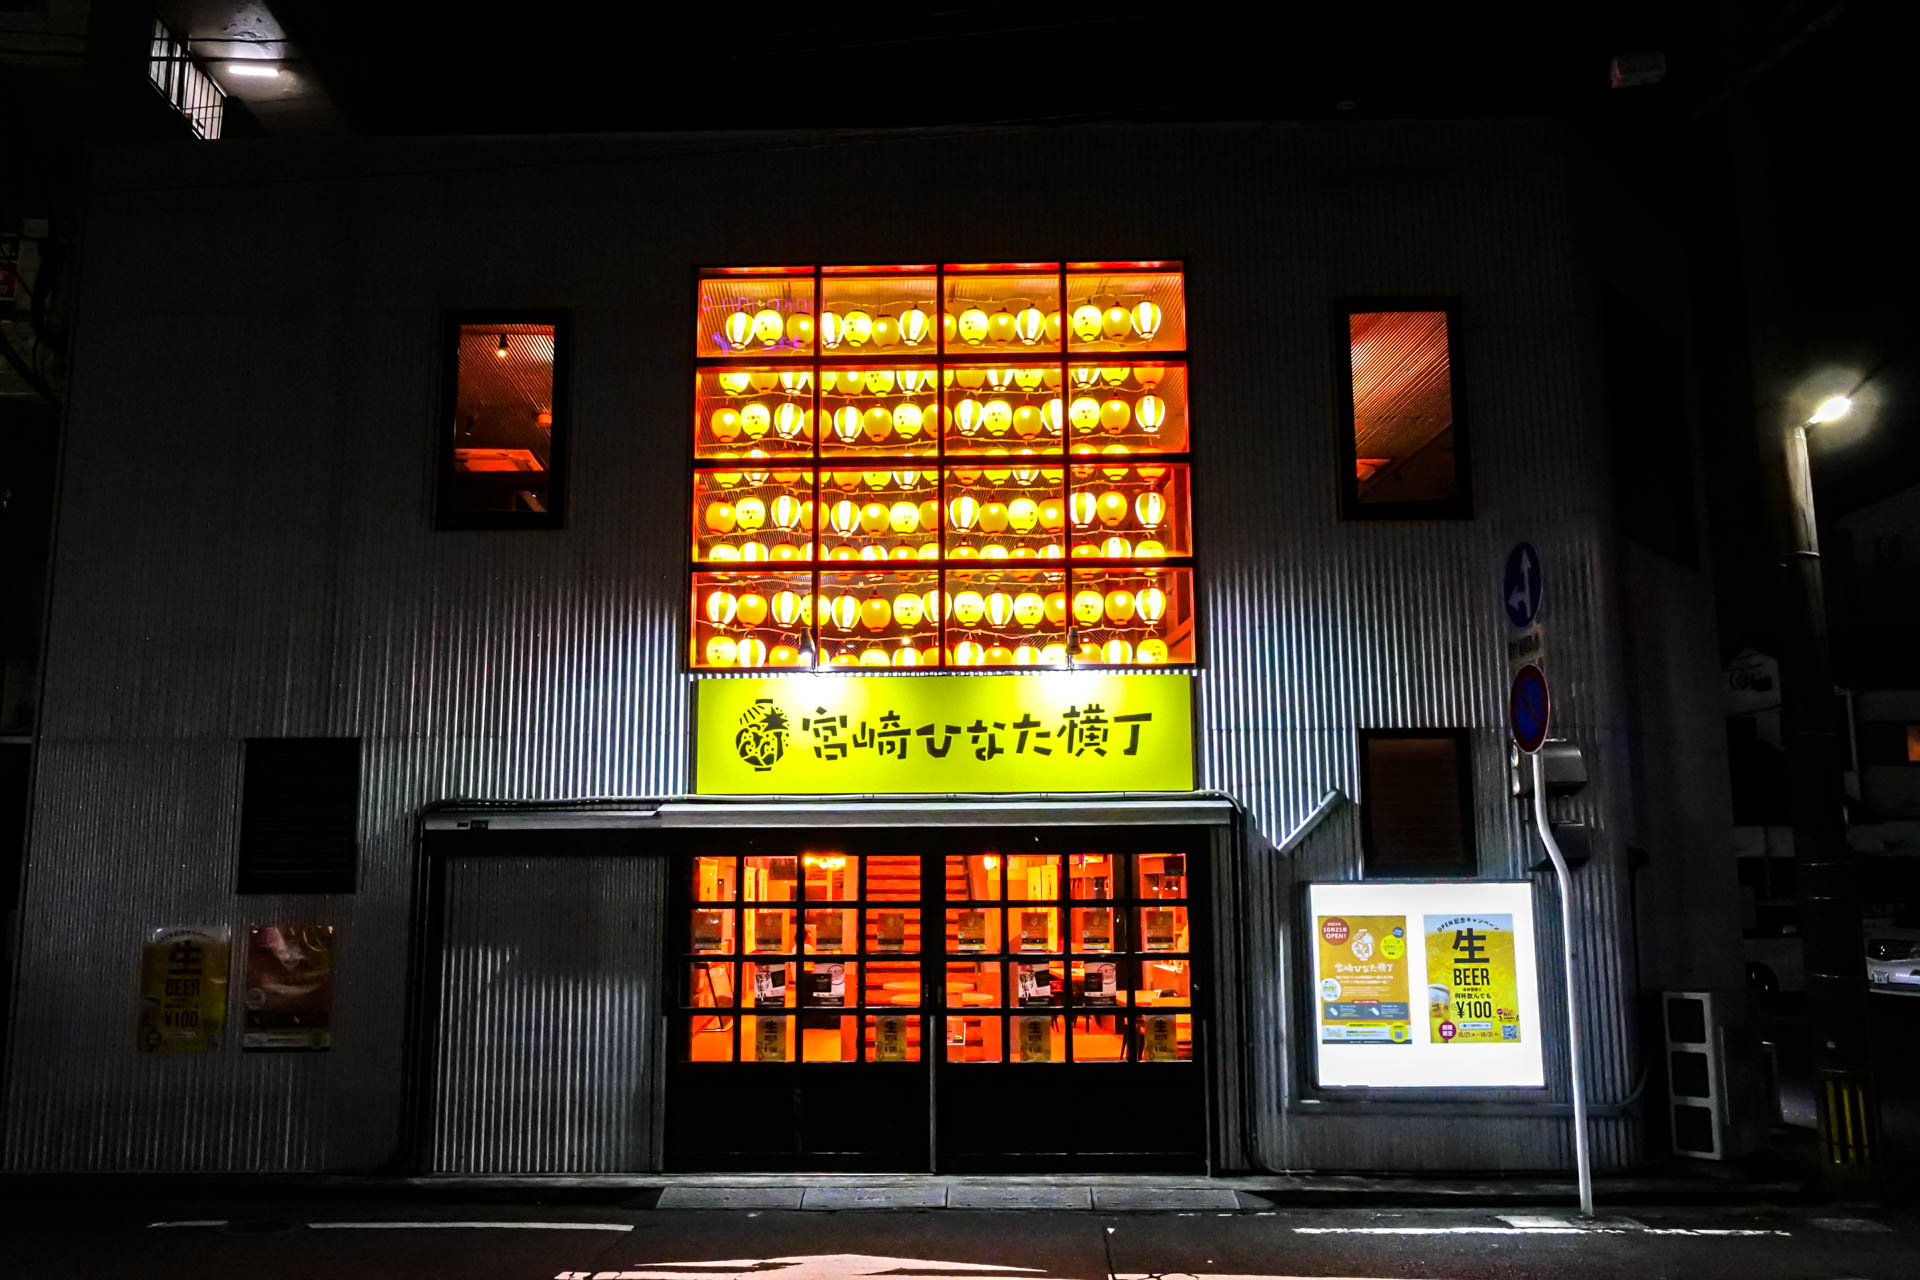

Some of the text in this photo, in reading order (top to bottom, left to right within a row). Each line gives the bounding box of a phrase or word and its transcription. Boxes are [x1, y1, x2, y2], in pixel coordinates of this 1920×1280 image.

[802, 703, 1152, 762] 宮崎ひなた横丁
[1437, 917, 1500, 932] OPEN記念キャンペーン
[1452, 928, 1490, 963] 生
[169, 940, 202, 974] 生
[1453, 968, 1490, 986] BEER
[166, 979, 200, 996] BEER
[1456, 1001, 1492, 1018] ¥100
[165, 1010, 199, 1027] ¥100
